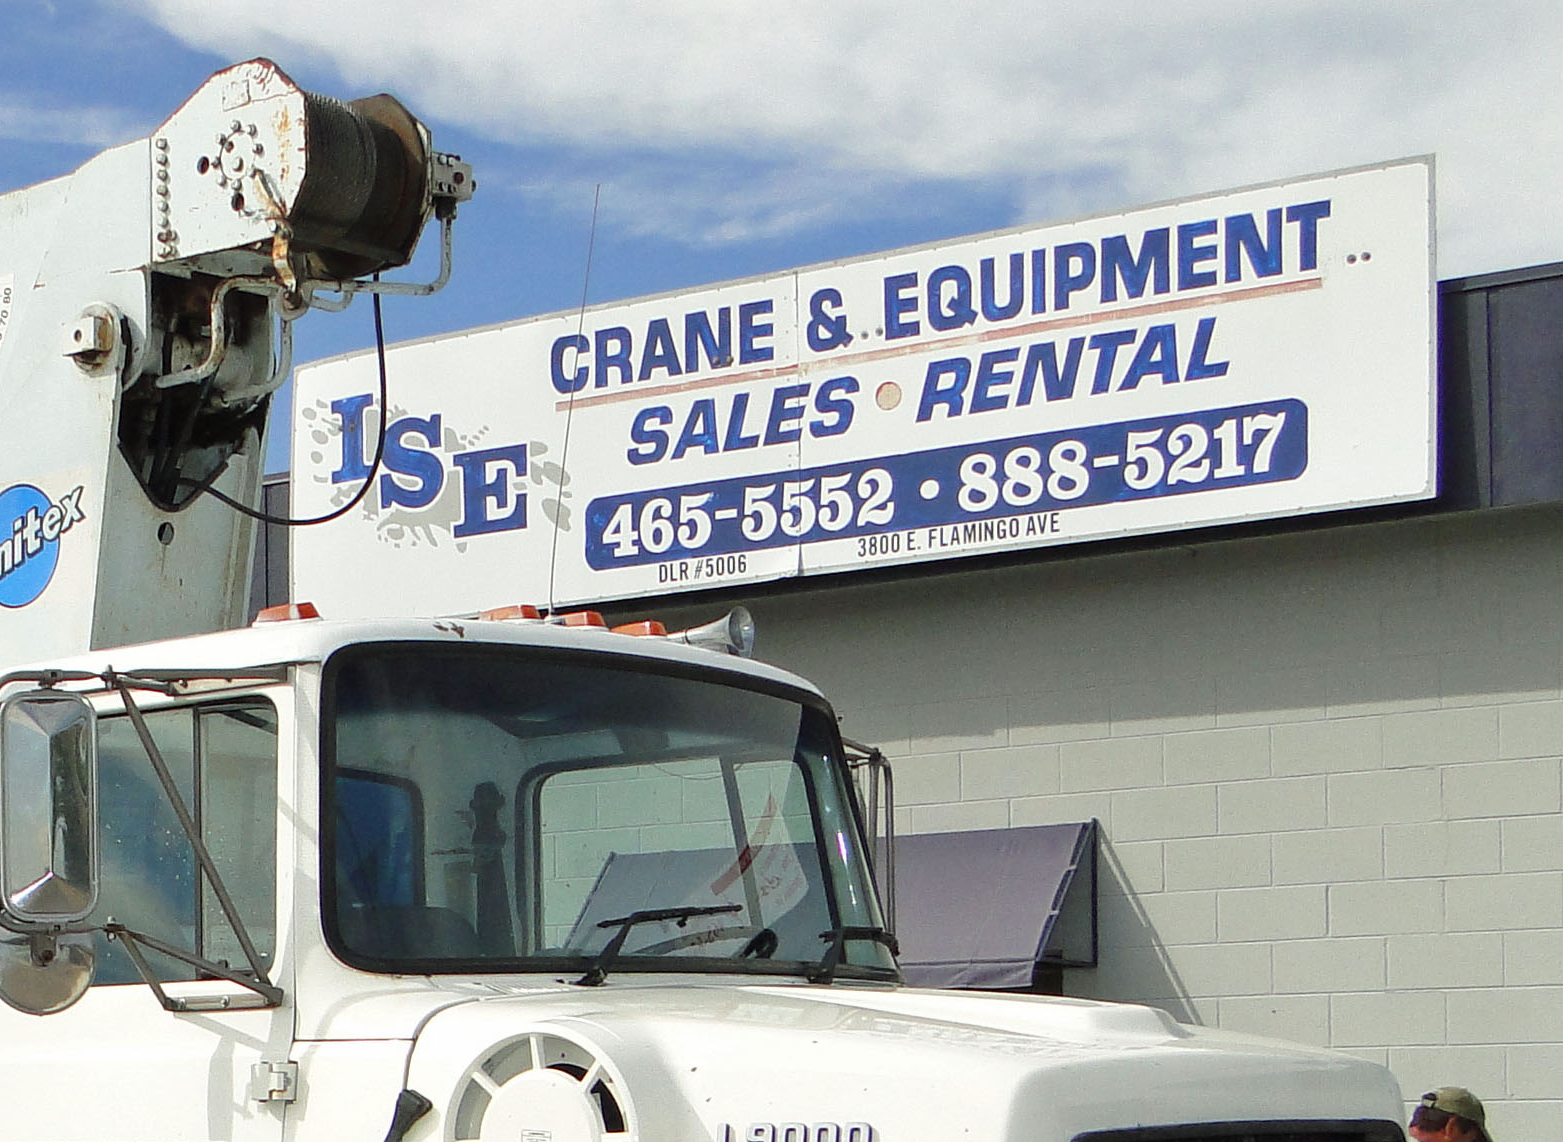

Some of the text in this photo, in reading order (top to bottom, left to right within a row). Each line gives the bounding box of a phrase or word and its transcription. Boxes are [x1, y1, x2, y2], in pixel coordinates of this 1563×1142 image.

[0, 309, 9, 326] 70
[3, 287, 12, 304] 80
[549, 200, 1332, 395] CRANE & EQUIPMENT
[627, 316, 1231, 468] SALES RENTAL
[331, 392, 527, 538] ISE
[601, 410, 1287, 558] 465-5552 888-5217
[658, 555, 747, 584] DLR #5006
[857, 512, 1060, 557] 3800 E. FLAMINGO AVE
